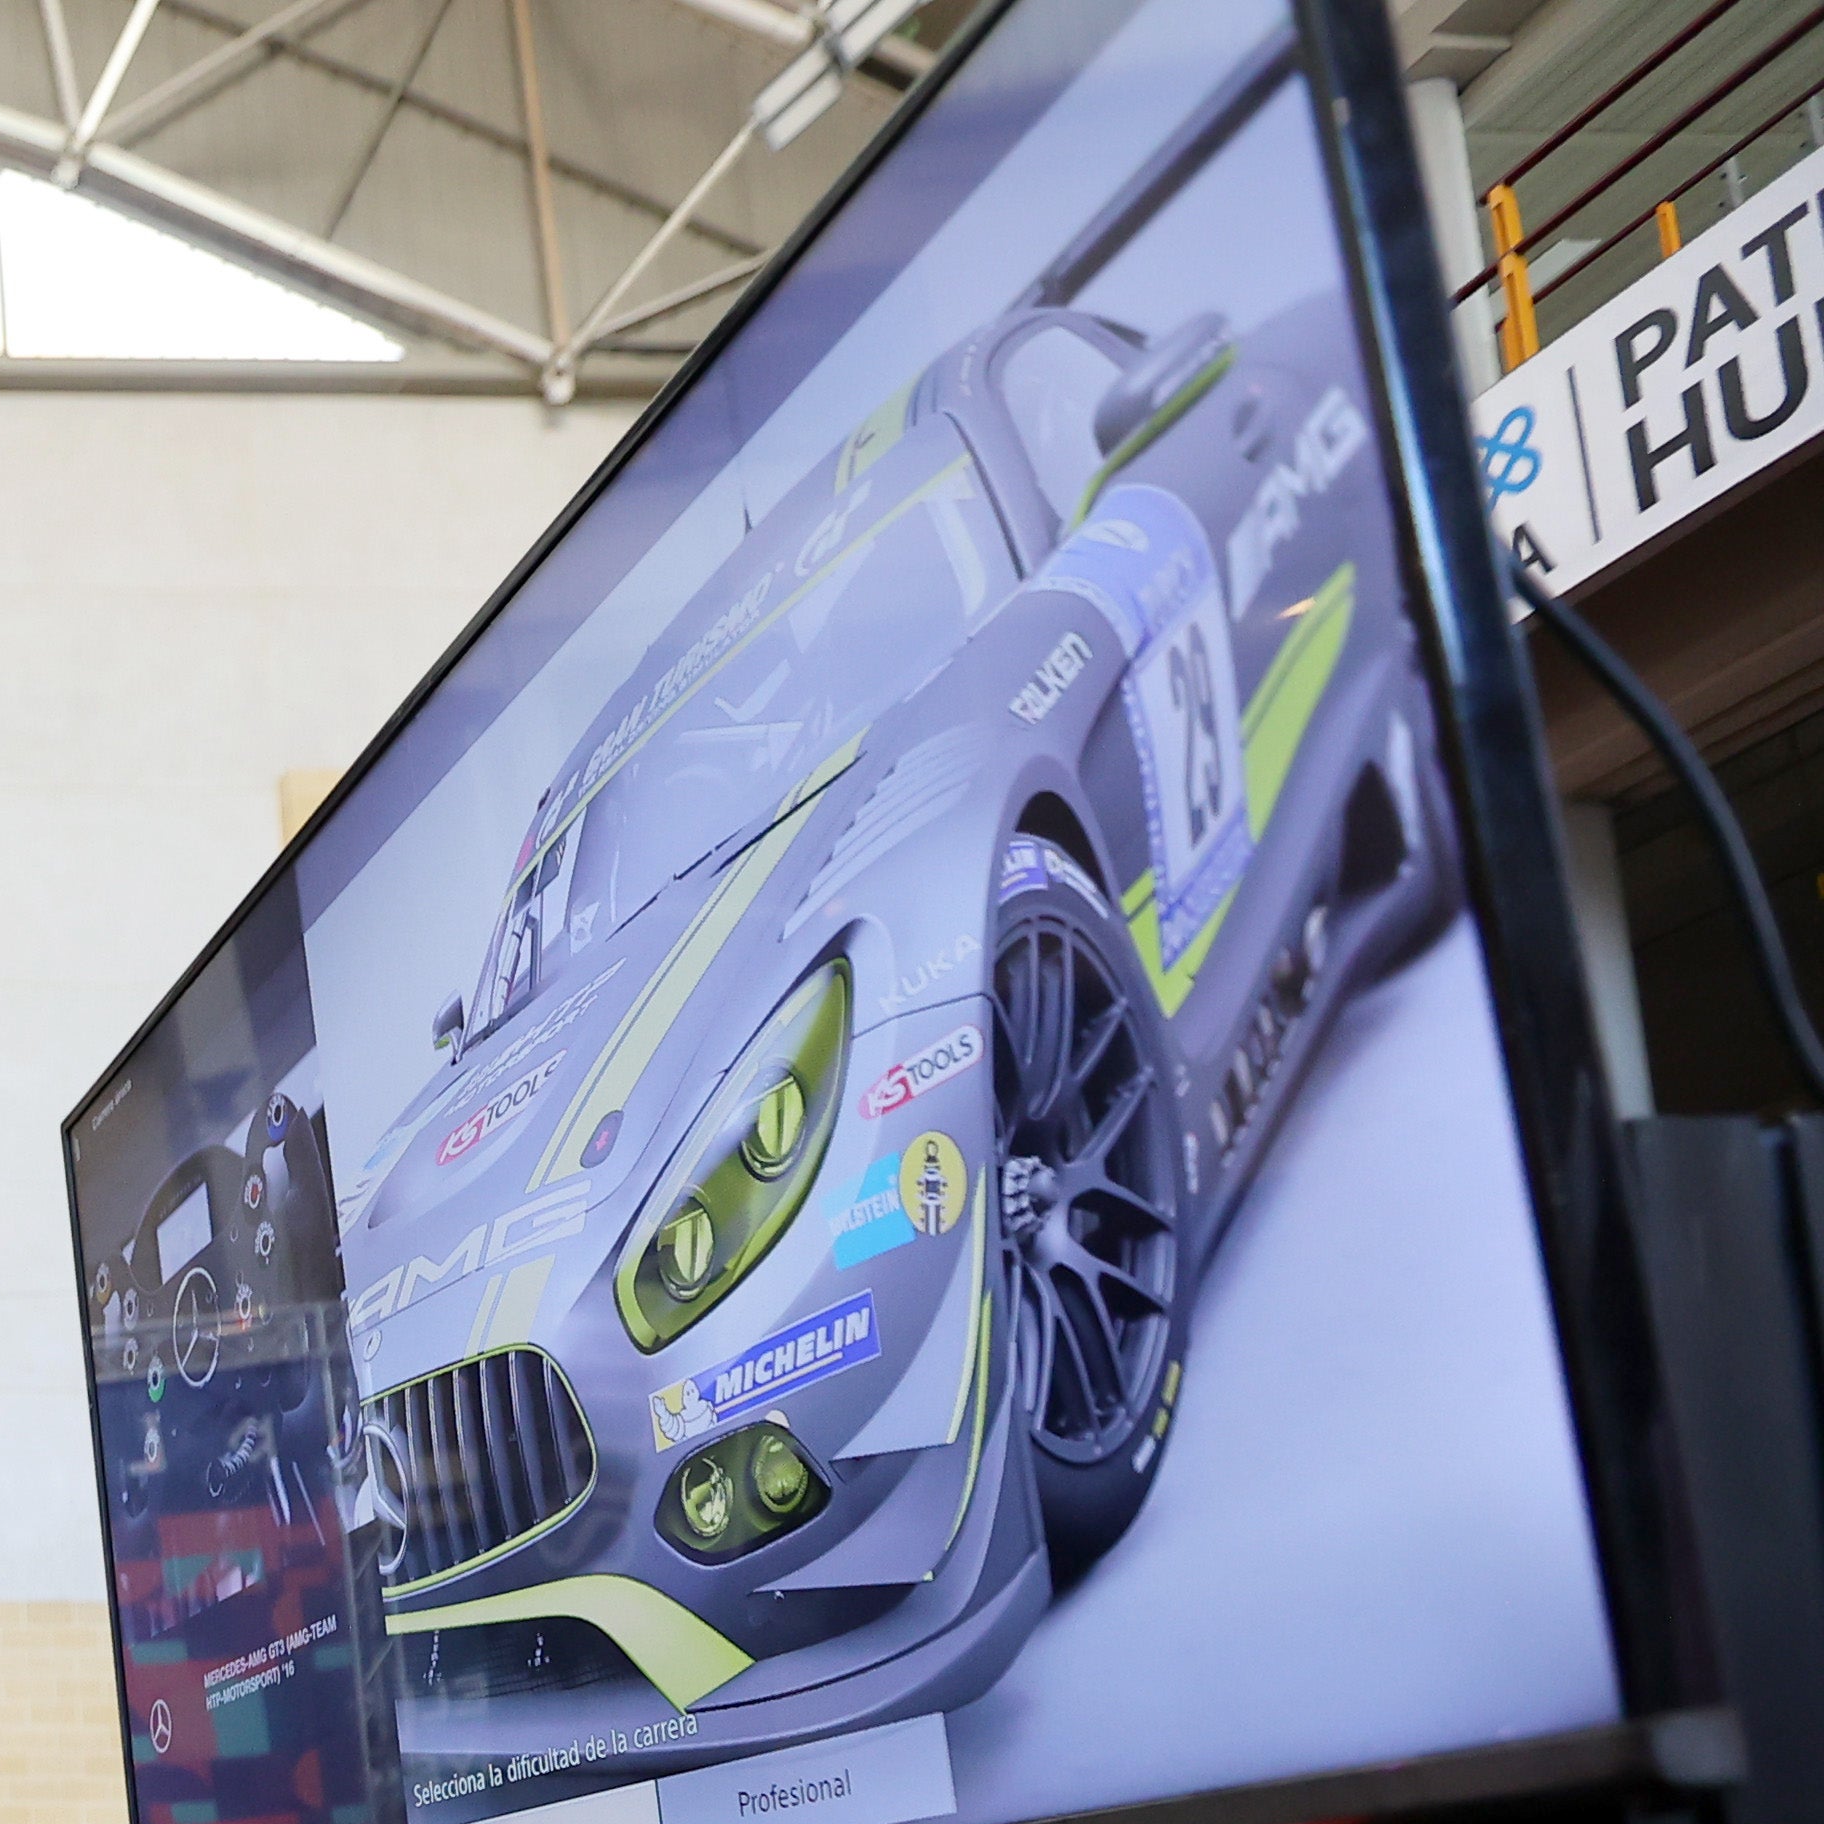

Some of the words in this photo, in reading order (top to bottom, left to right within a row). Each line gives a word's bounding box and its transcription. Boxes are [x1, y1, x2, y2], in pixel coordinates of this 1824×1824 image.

[1613, 188, 1824, 412] PAT
[1624, 297, 1824, 514] HU
[1227, 386, 1367, 623] AMG
[1009, 631, 1093, 725] FALKEN
[866, 1070, 907, 1117] KS
[907, 1033, 974, 1086] TOOLS
[349, 1180, 592, 1332] AMG
[714, 1306, 871, 1404] MICHELIN
[203, 1647, 268, 1689] MERCEDES-AMG
[267, 1638, 285, 1660] GT3
[285, 1613, 337, 1655] (AMG-TEAM
[205, 1665, 281, 1712] HTP-MOTORSPORT)
[413, 1763, 486, 1808] Selecciona
[488, 1762, 504, 1788] la
[505, 1739, 581, 1786] dificultad
[584, 1733, 608, 1761] de
[610, 1727, 630, 1756] la
[632, 1712, 699, 1751] carrera
[737, 1769, 852, 1817] Profesional
